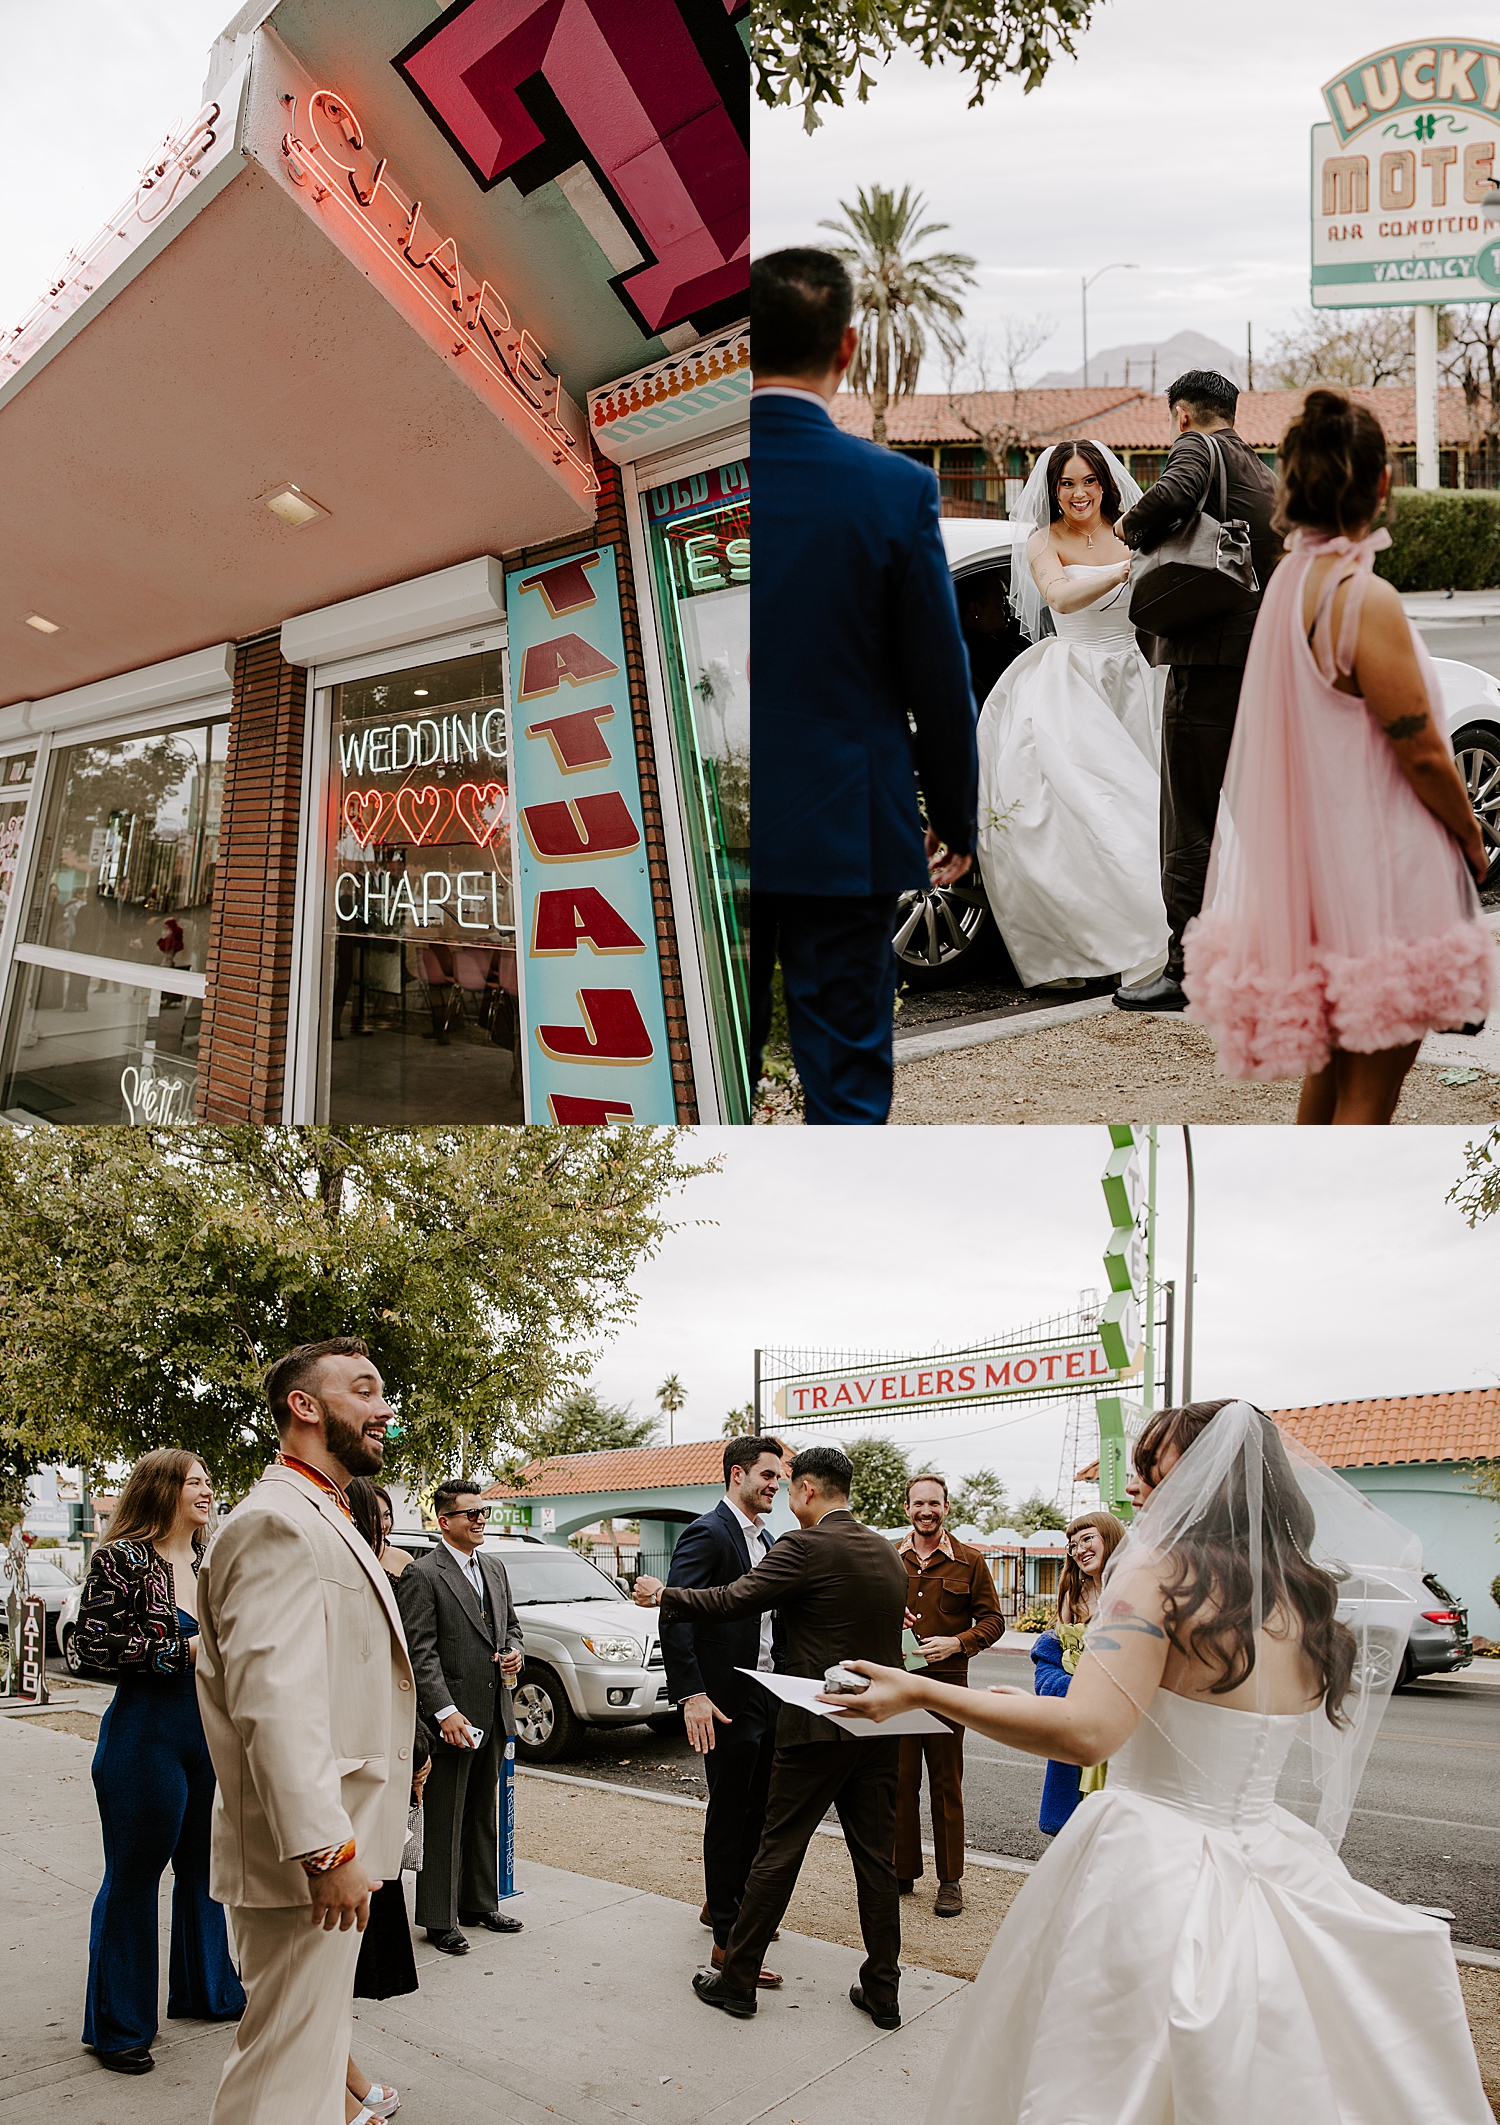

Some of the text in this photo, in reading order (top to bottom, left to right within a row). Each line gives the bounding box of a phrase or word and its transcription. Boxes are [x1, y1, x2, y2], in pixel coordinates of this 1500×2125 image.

[1328, 224, 1364, 242] AIR
[1372, 257, 1474, 282] VACANCY
[651, 472, 709, 517] OLD
[339, 708, 507, 778] WEDDING
[335, 870, 516, 930] CHAPEL
[792, 1349, 1109, 1411] TRAVELERS MOTEL
[23, 1601, 40, 1693] TATTOO
